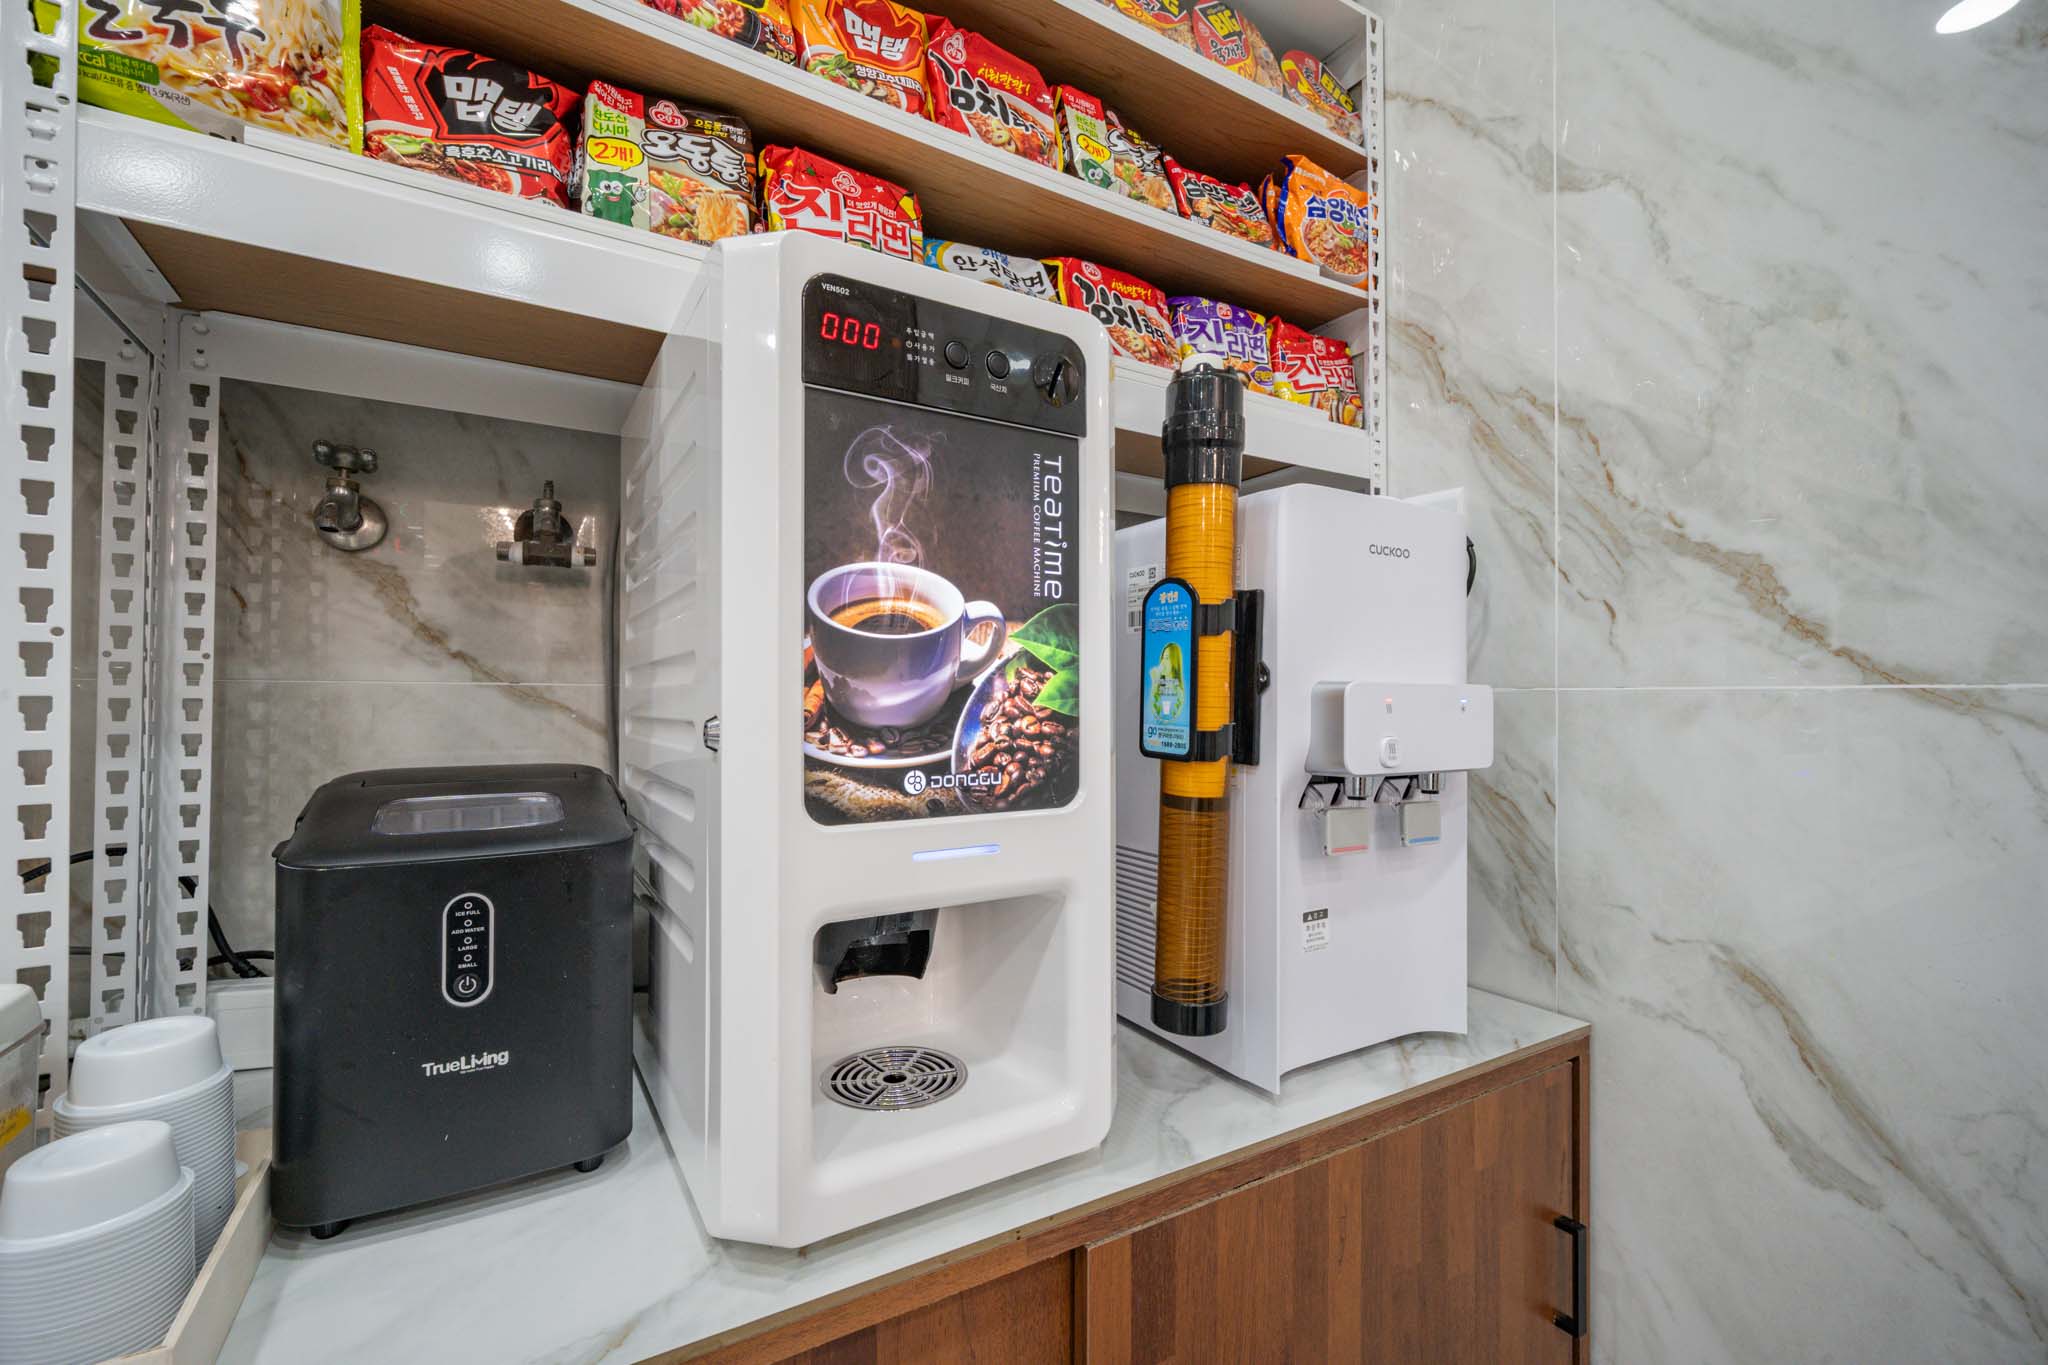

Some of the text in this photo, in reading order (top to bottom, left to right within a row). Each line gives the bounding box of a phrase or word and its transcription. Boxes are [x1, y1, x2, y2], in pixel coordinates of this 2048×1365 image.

[843, 8, 910, 61] 맵탱
[1207, 10, 1241, 37] BIG
[1210, 39, 1247, 62] 육개장
[443, 74, 542, 134] 맵탱
[1321, 73, 1354, 112] BIG
[594, 142, 634, 163] 2개!
[777, 181, 912, 258] 진라면
[952, 254, 1048, 295] 안성탕면
[821, 312, 880, 351] 000
[1187, 318, 1267, 361] 진라면
[945, 373, 970, 386] 밀크커피
[1287, 353, 1357, 393] 진라면
[1032, 453, 1041, 597] PREMIUM COFFEE MACHINE
[1369, 543, 1410, 559] CUCKOO
[930, 772, 1002, 789] DONGGU
[464, 926, 485, 934] WATER
[457, 944, 479, 952] LARGE
[422, 1050, 509, 1077] TrueLiving
